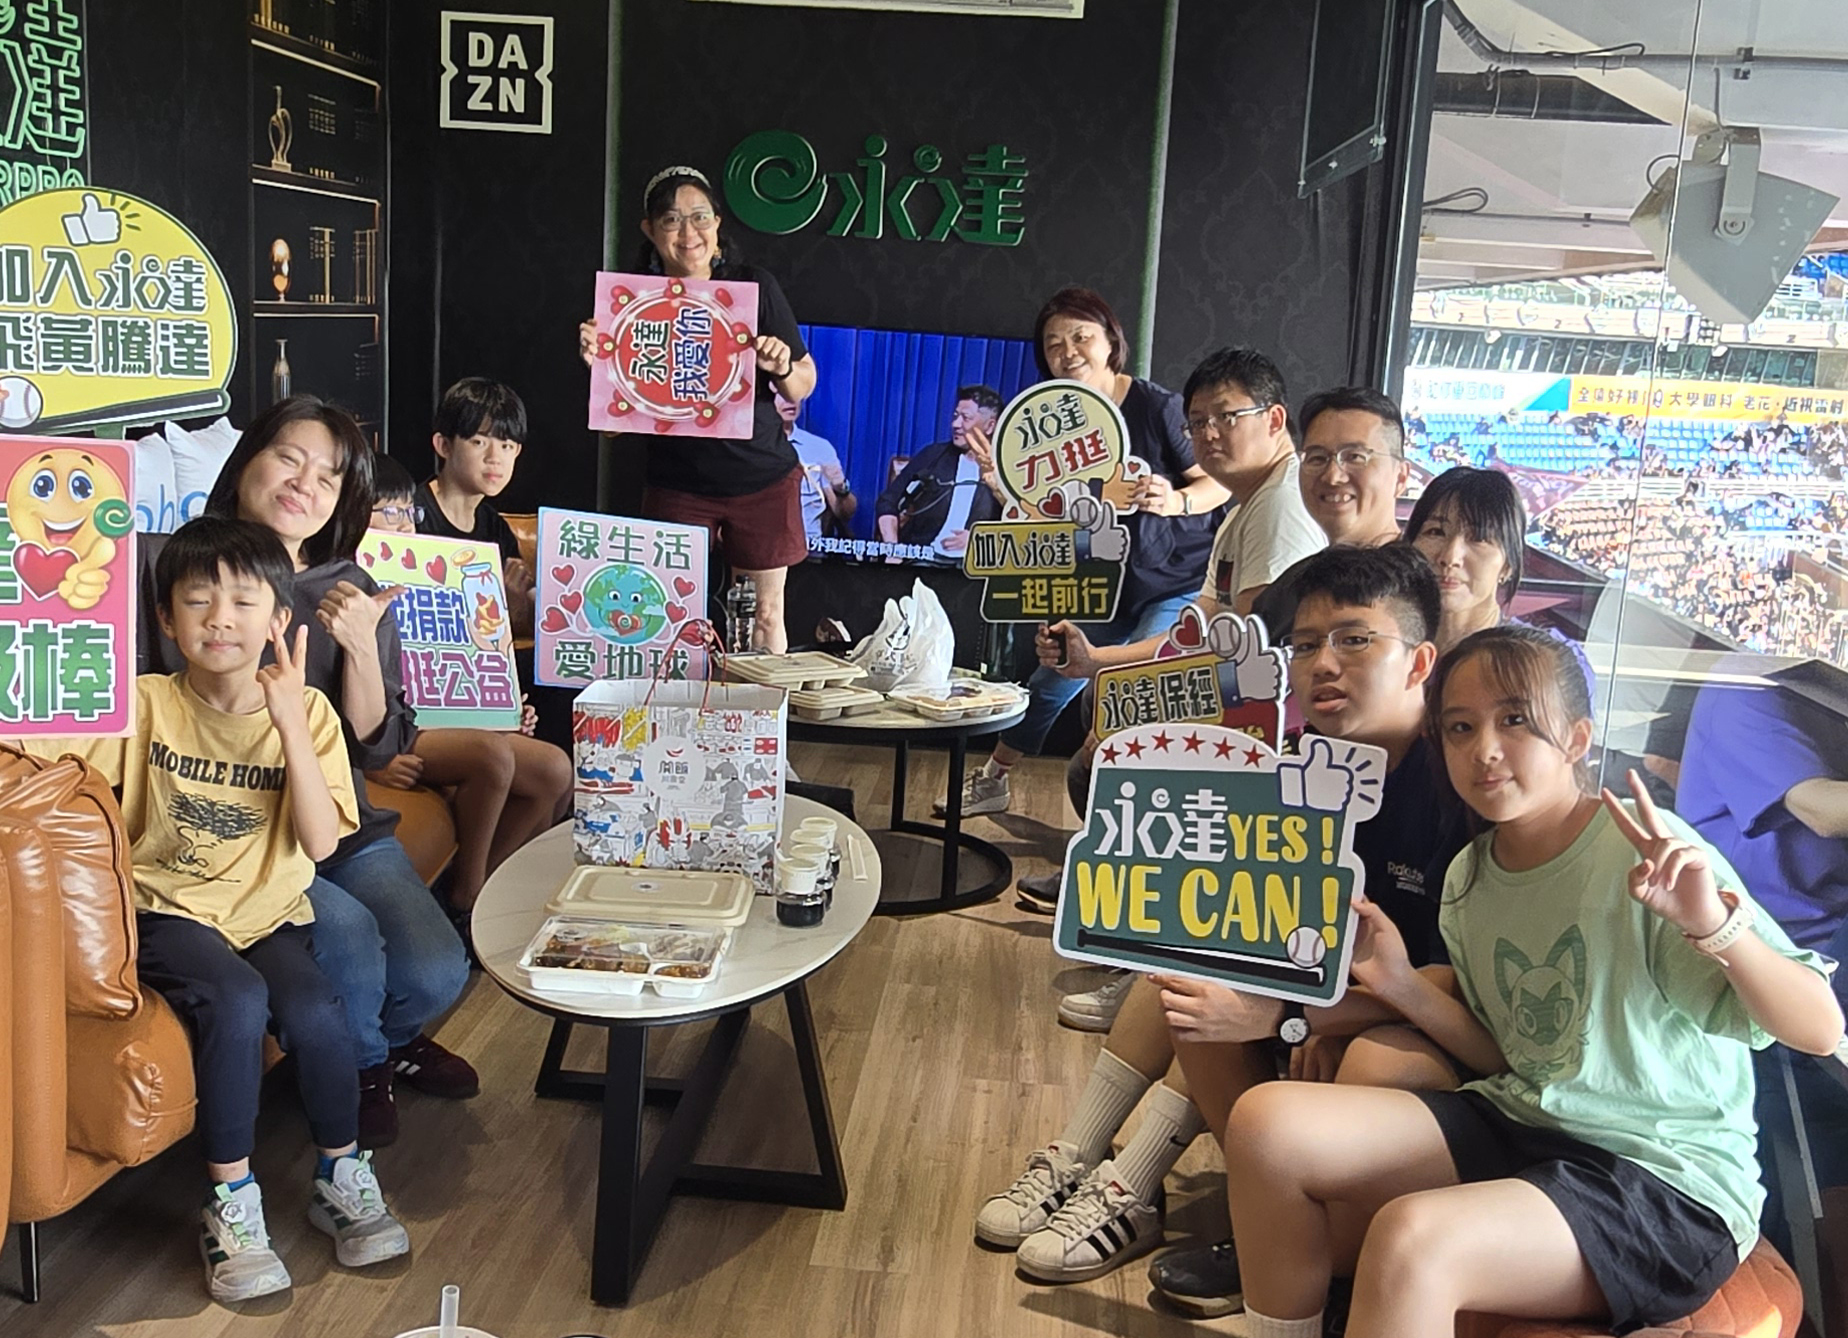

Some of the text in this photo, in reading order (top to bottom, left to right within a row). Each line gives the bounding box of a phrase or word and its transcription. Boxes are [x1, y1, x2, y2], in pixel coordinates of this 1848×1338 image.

[826, 134, 1029, 247] 永達
[631, 321, 670, 384] 永達
[673, 307, 713, 402] 我愛你
[1015, 393, 1088, 450] 永達
[1016, 429, 1111, 491] 力挺
[559, 519, 692, 571] 綠生活
[973, 525, 1074, 569] 加入永達
[992, 577, 1108, 615] 一起前行
[0, 622, 112, 721] 棒
[555, 640, 689, 680] 愛地球
[1101, 666, 1220, 731] 永達保經
[148, 741, 288, 791] MOBILE HOM
[1094, 781, 1229, 862] 永達
[1077, 861, 1163, 933] WE
